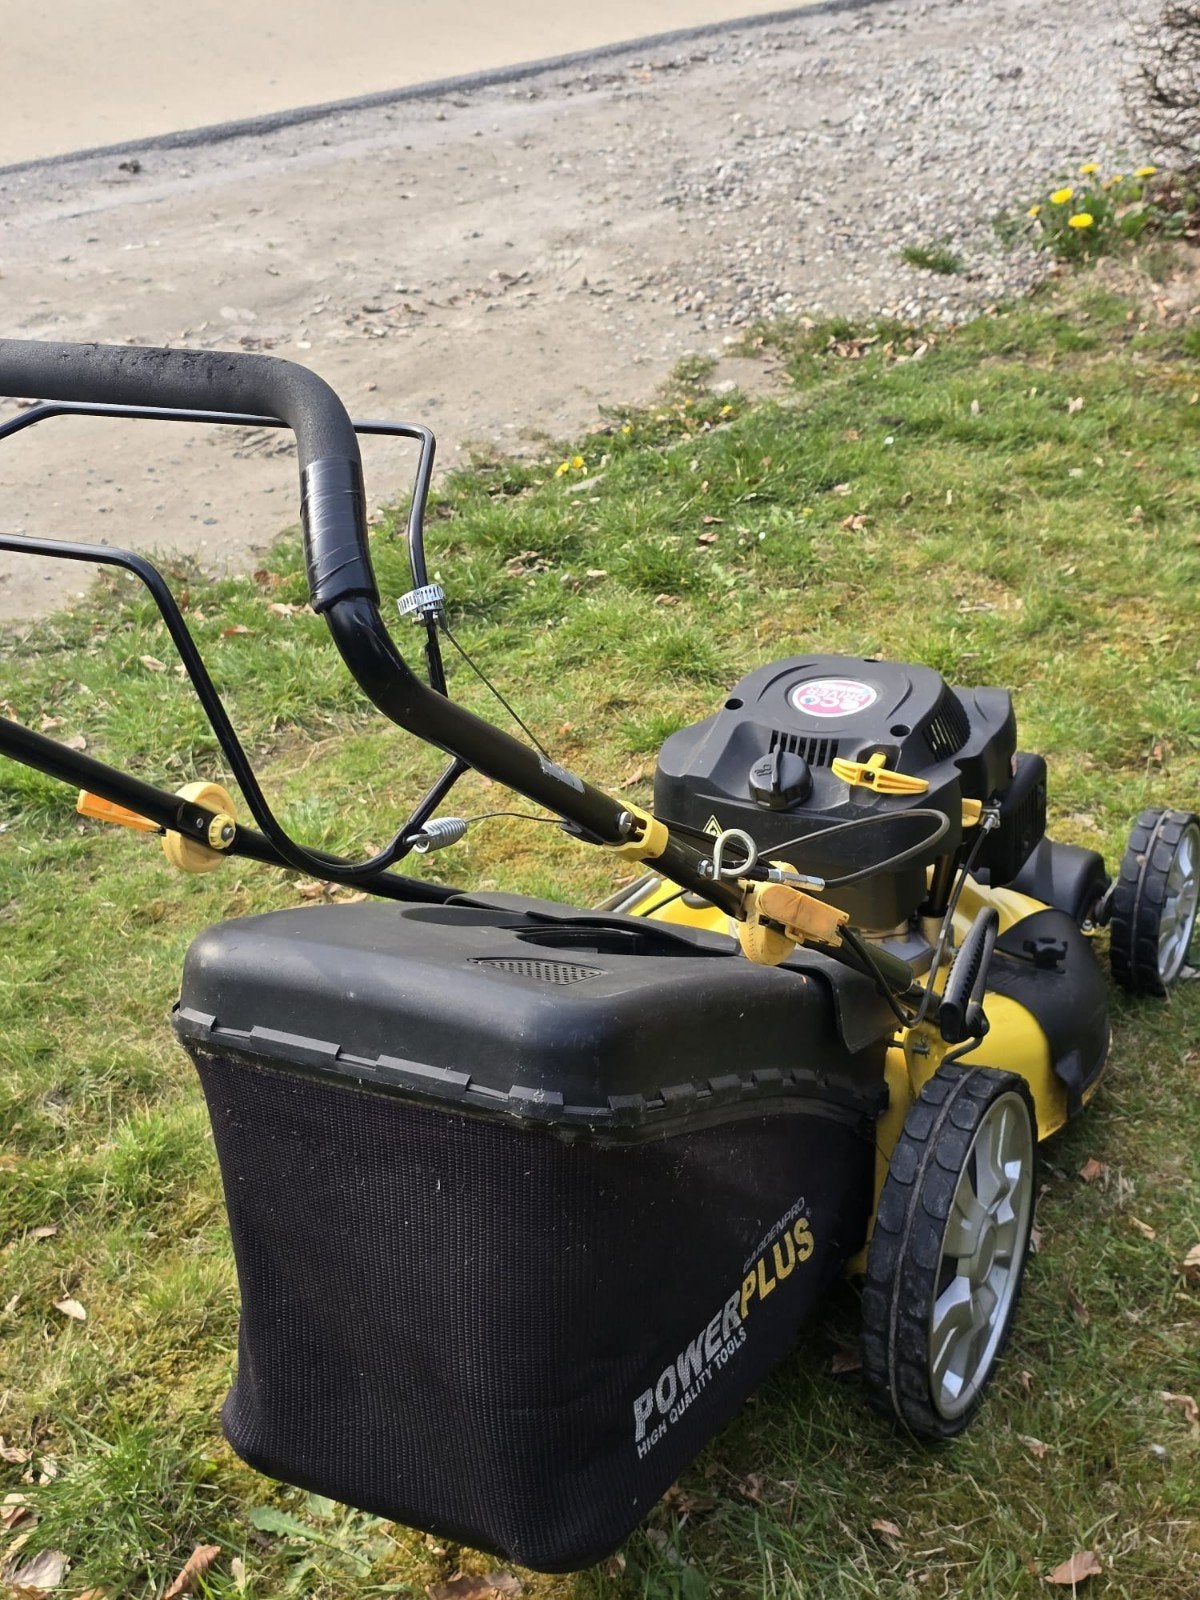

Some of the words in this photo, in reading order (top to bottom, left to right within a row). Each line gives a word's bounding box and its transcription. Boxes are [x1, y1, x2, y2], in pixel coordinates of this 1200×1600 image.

[633, 1217, 814, 1442] POWERPLUS
[637, 1419, 668, 1459] HIGH
[669, 1364, 713, 1424] QUALITY
[713, 1326, 747, 1370] TOOLS
